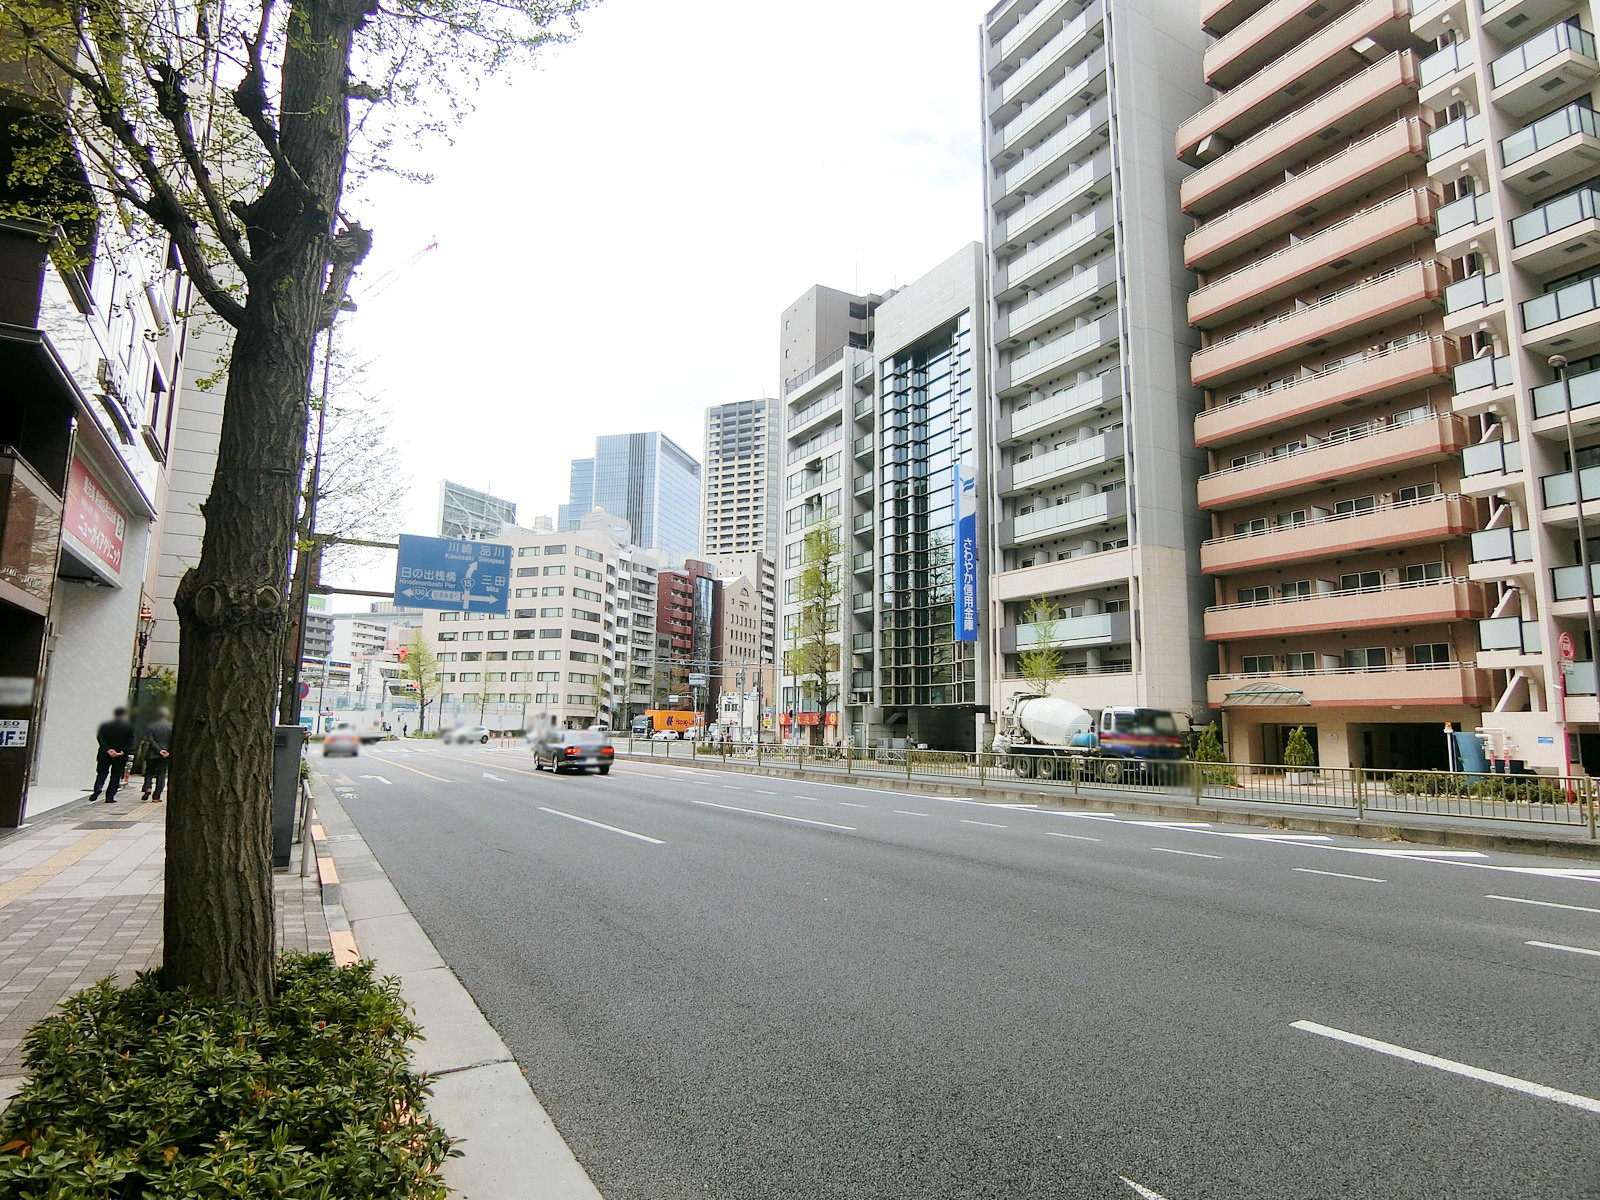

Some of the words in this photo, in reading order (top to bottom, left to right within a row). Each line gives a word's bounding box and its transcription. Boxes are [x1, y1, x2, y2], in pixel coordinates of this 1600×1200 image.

[448, 542, 473, 554] 川崎
[480, 546, 504, 557] 品川
[445, 552, 475, 561] Kawasaki
[479, 556, 505, 565] Shinagawa
[401, 566, 456, 582] 日の出桟橋
[481, 575, 505, 586] 三田
[463, 580, 472, 588] 15
[486, 585, 499, 593] Mita
[963, 538, 974, 631] さわやか信用金庫
